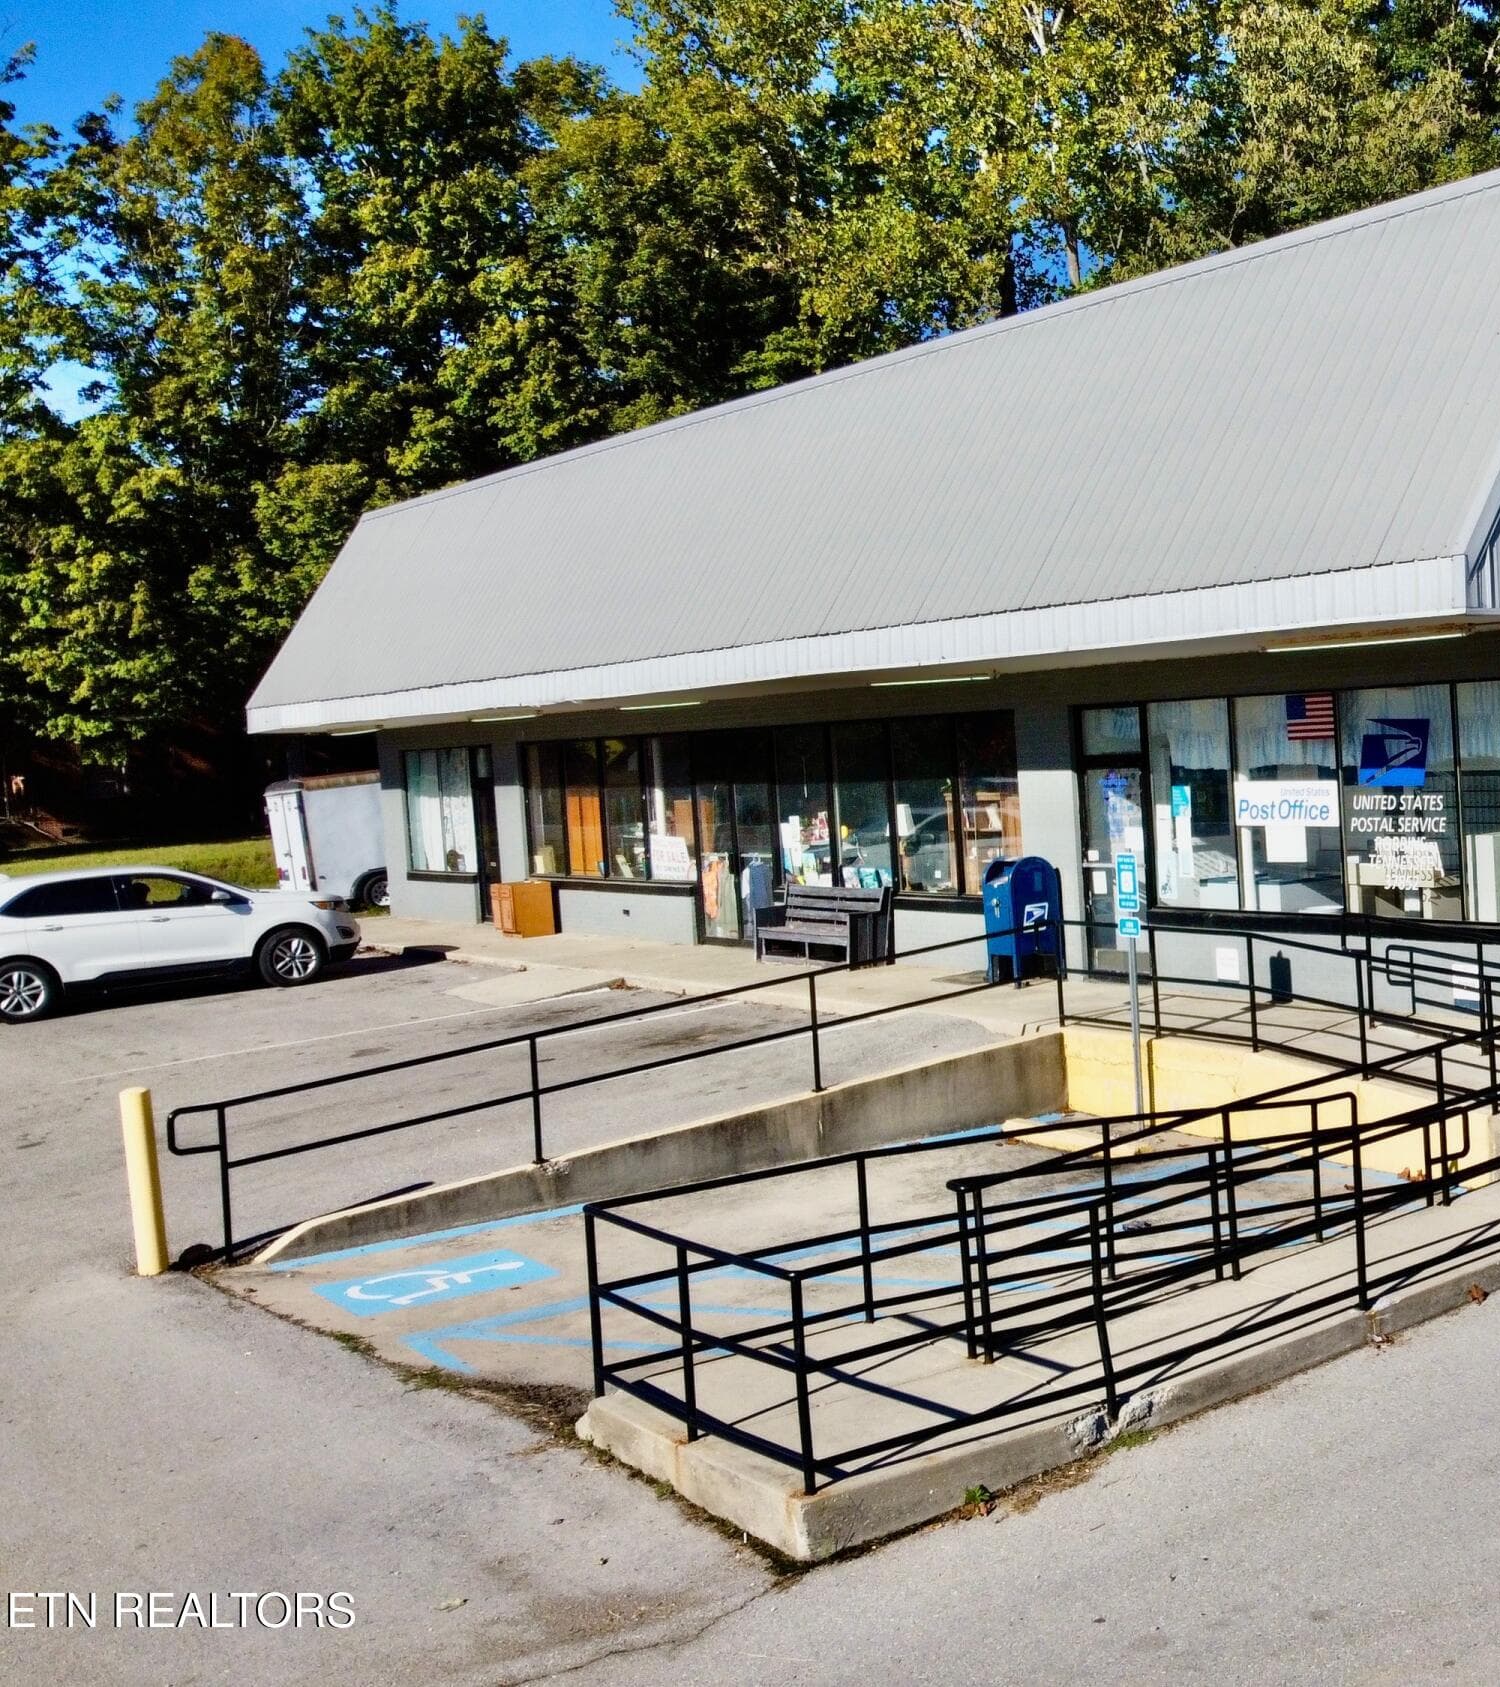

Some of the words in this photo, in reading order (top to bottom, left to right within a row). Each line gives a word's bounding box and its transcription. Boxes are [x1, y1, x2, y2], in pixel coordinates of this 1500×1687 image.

[1280, 788, 1305, 797] United
[1306, 787, 1330, 797] States
[1238, 799, 1276, 820] Post
[1278, 799, 1330, 821] Office
[1353, 794, 1396, 811] UNITED
[1400, 794, 1444, 811] STATES
[1350, 816, 1395, 833] POSTAL
[1397, 816, 1447, 833] SERVICE
